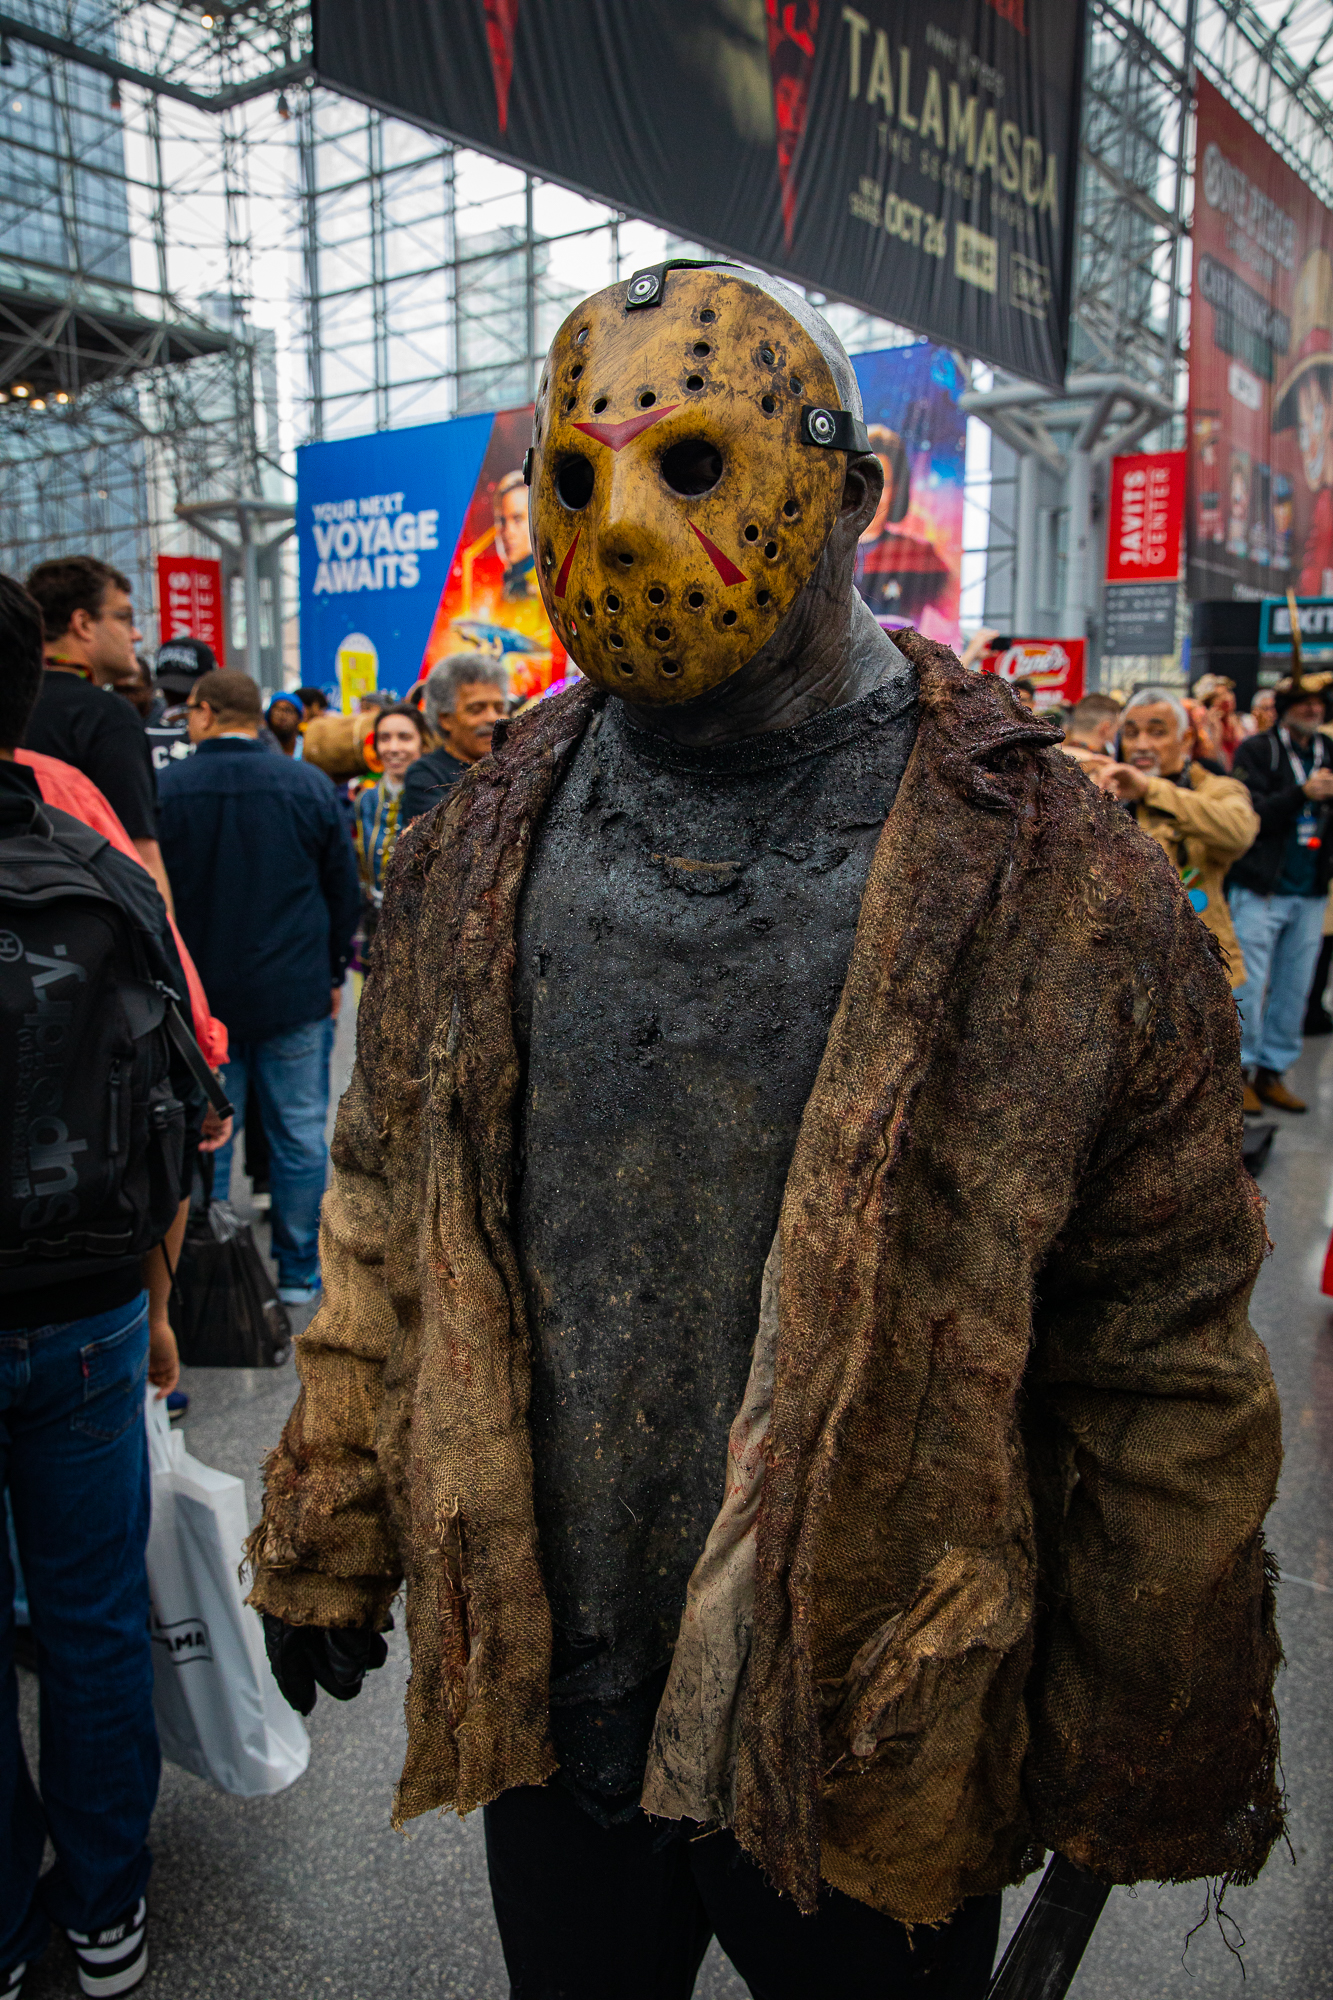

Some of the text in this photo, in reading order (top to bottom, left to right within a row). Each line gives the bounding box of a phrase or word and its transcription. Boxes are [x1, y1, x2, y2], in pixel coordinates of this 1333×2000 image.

[842, 6, 1059, 228] TALAMASCA
[885, 192, 923, 247] OCT
[312, 491, 405, 522] YOUR NEXT
[312, 509, 439, 561] VOYAGE
[1119, 469, 1146, 565] JAVITS
[1146, 467, 1170, 565] CENTER
[168, 571, 192, 639] VITS
[312, 553, 420, 596] AWAITS
[197, 573, 215, 648] NTER
[97, 1923, 126, 1946] NIKE
